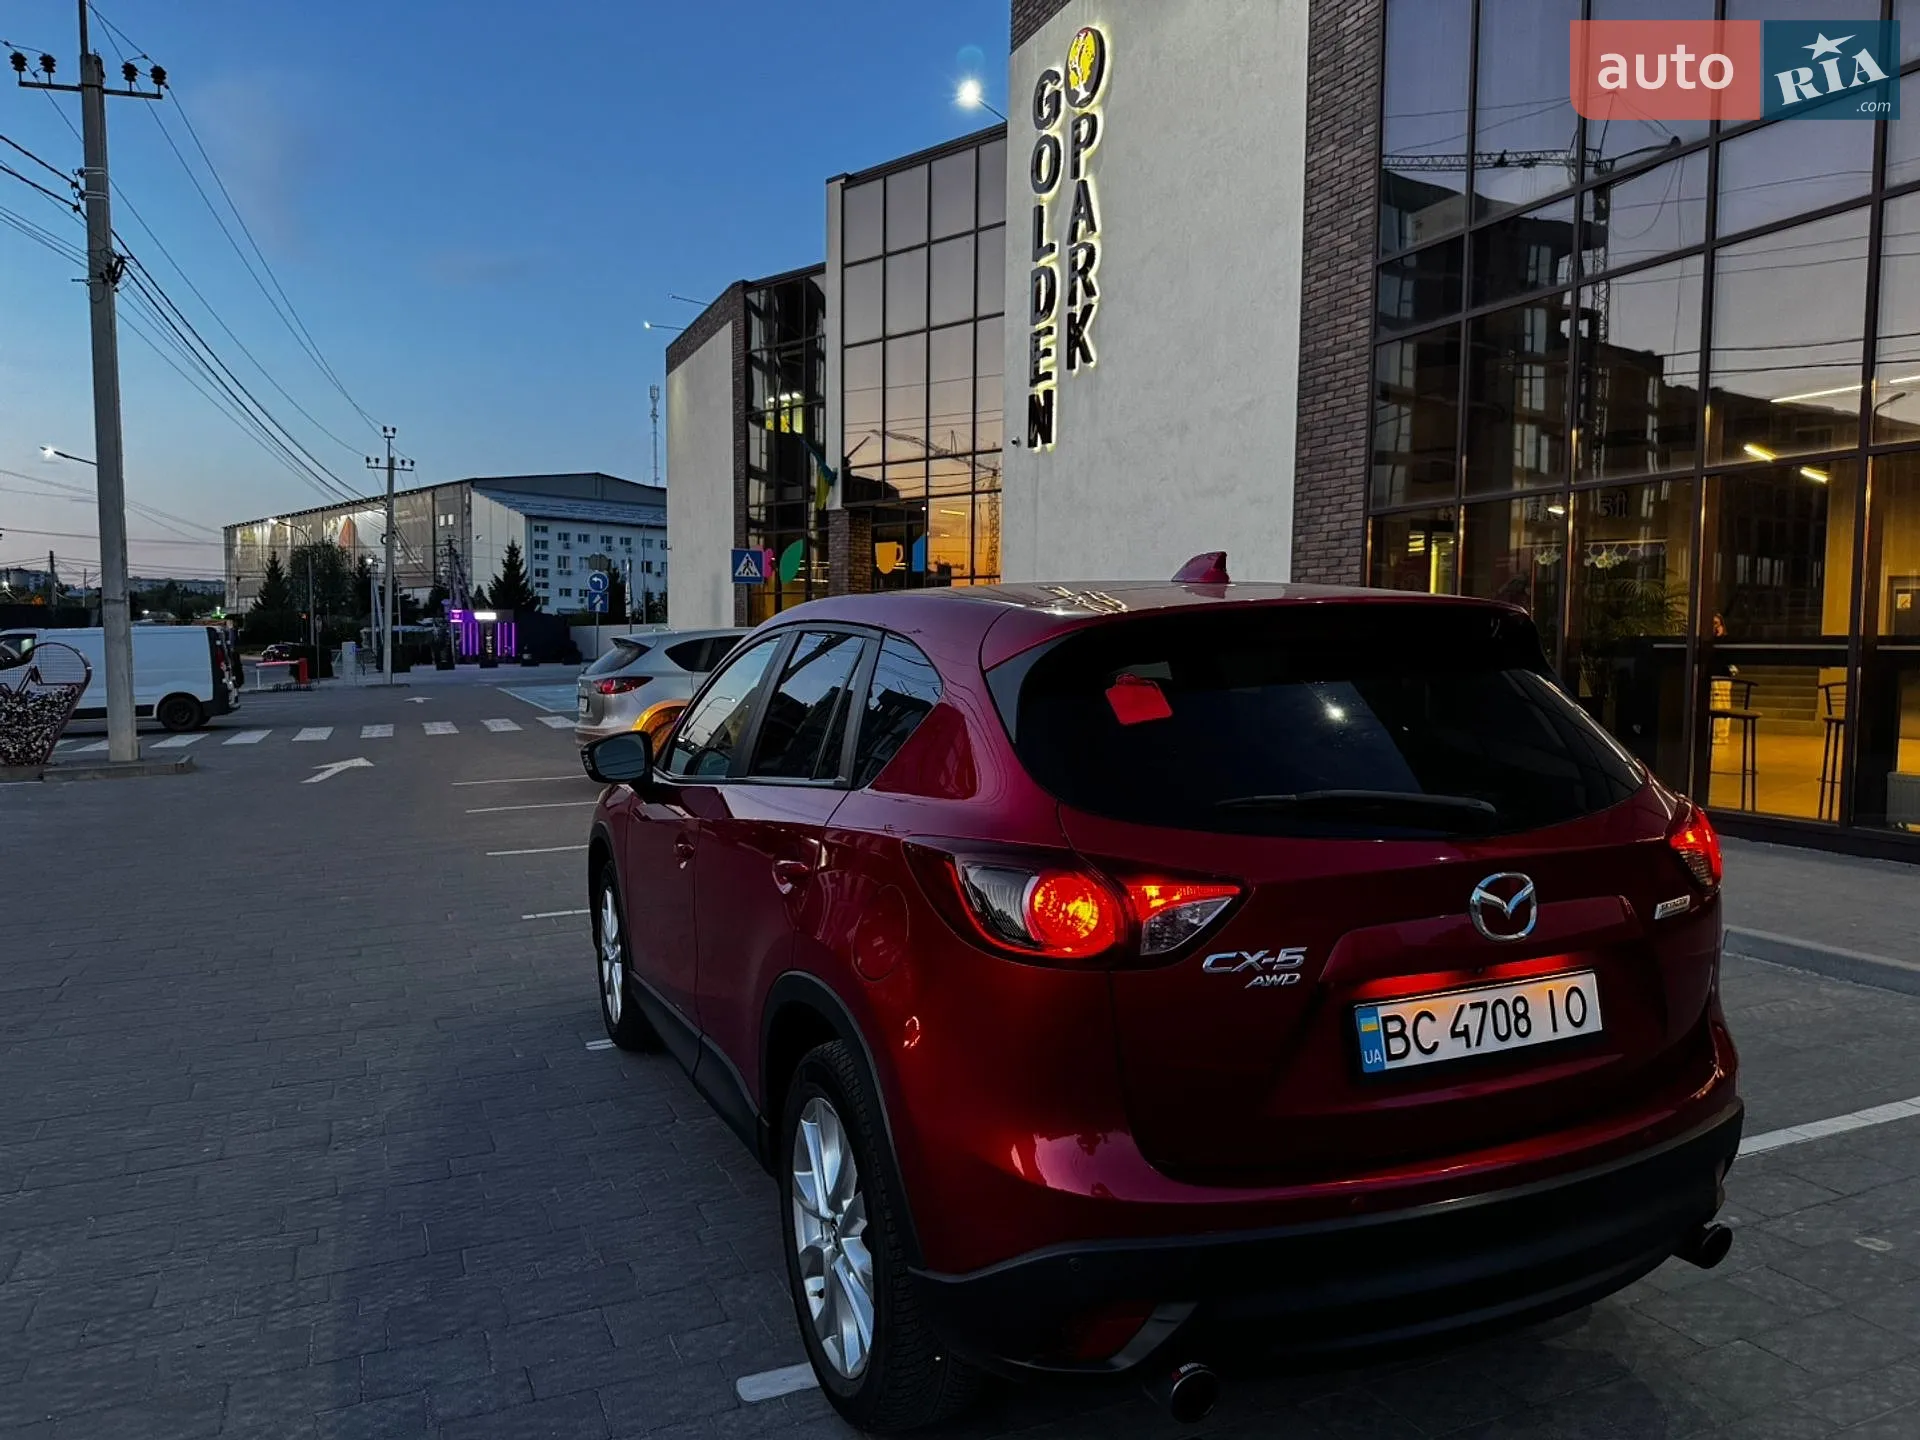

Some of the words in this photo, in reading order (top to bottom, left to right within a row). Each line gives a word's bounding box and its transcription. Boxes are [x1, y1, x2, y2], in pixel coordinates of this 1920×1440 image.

[1027, 67, 1063, 451] GOLDEN
[1066, 110, 1101, 373] PARK
[1202, 946, 1308, 975] CX-5
[1244, 973, 1301, 989] AWD
[1381, 1007, 1440, 1063] BC
[1450, 997, 1532, 1049] 4708
[1545, 984, 1588, 1034] IO
[1363, 1049, 1383, 1065] UA
